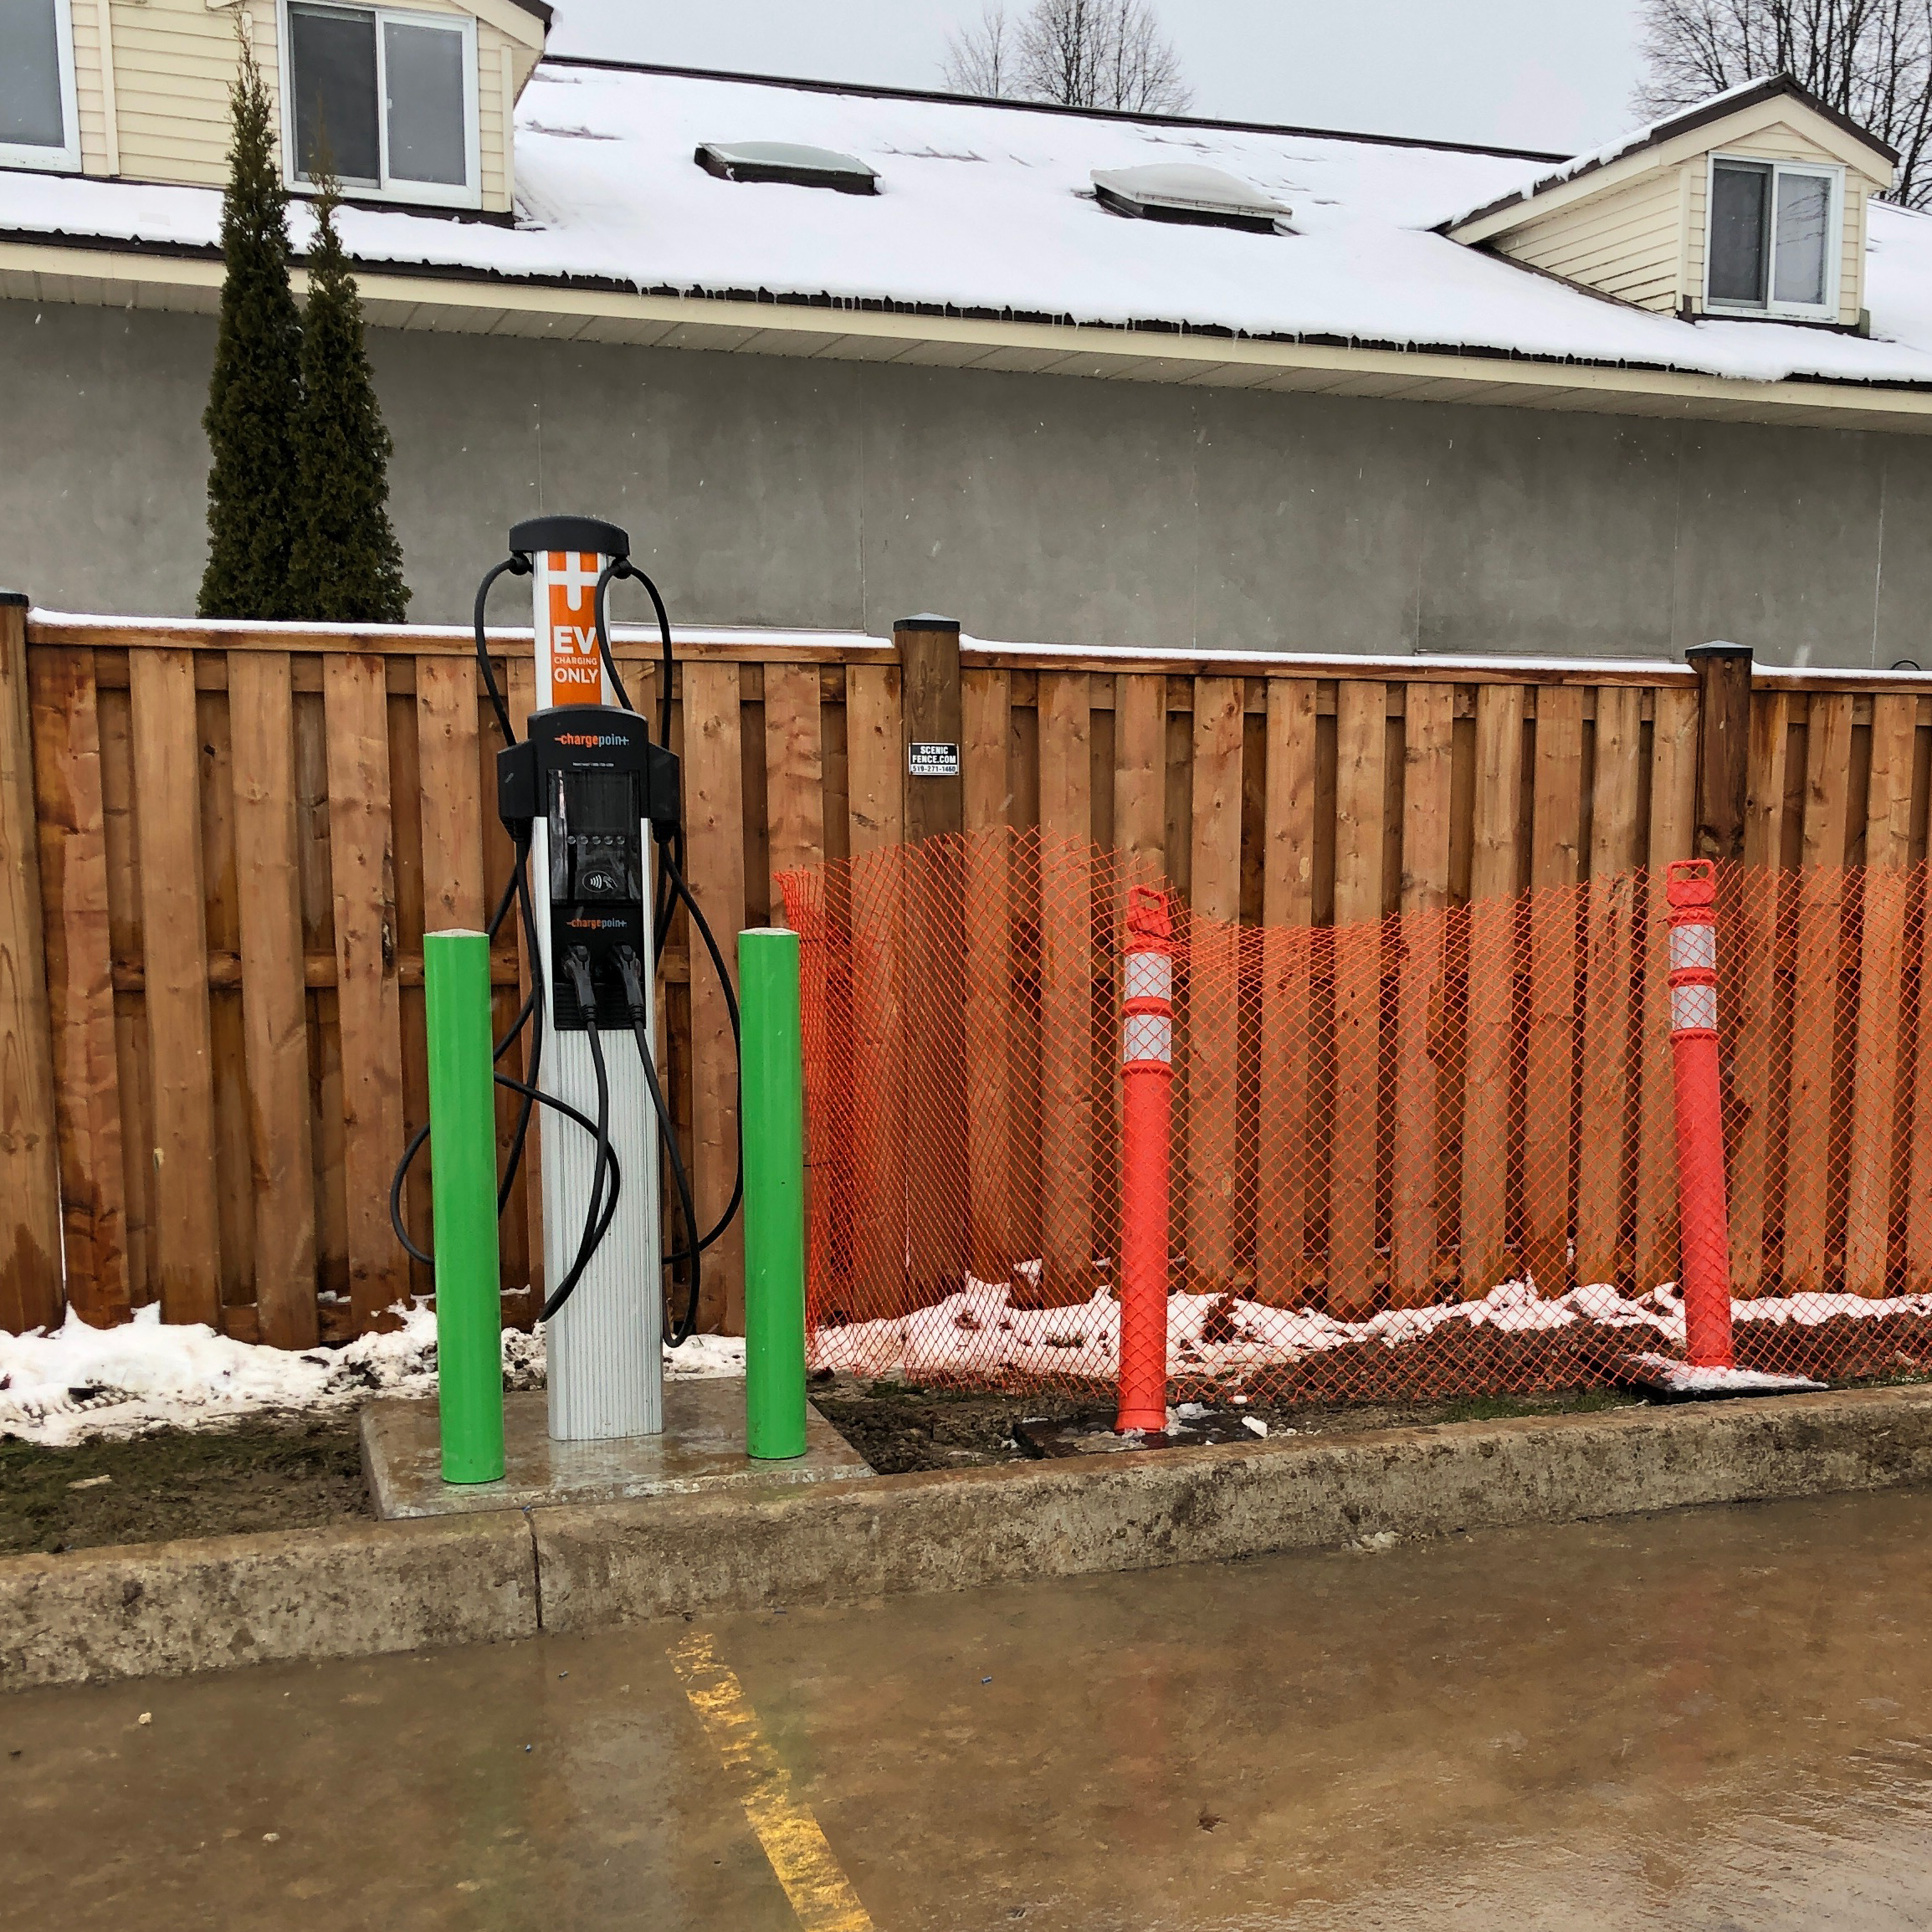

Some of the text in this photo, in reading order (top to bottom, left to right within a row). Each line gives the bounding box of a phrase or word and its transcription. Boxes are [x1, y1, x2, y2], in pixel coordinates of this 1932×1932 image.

[553, 626, 597, 655] EV
[554, 656, 597, 665] CHARGING
[554, 668, 598, 684] ONLY
[920, 746, 949, 755] SCENIC
[912, 755, 956, 764] FENCE.COM
